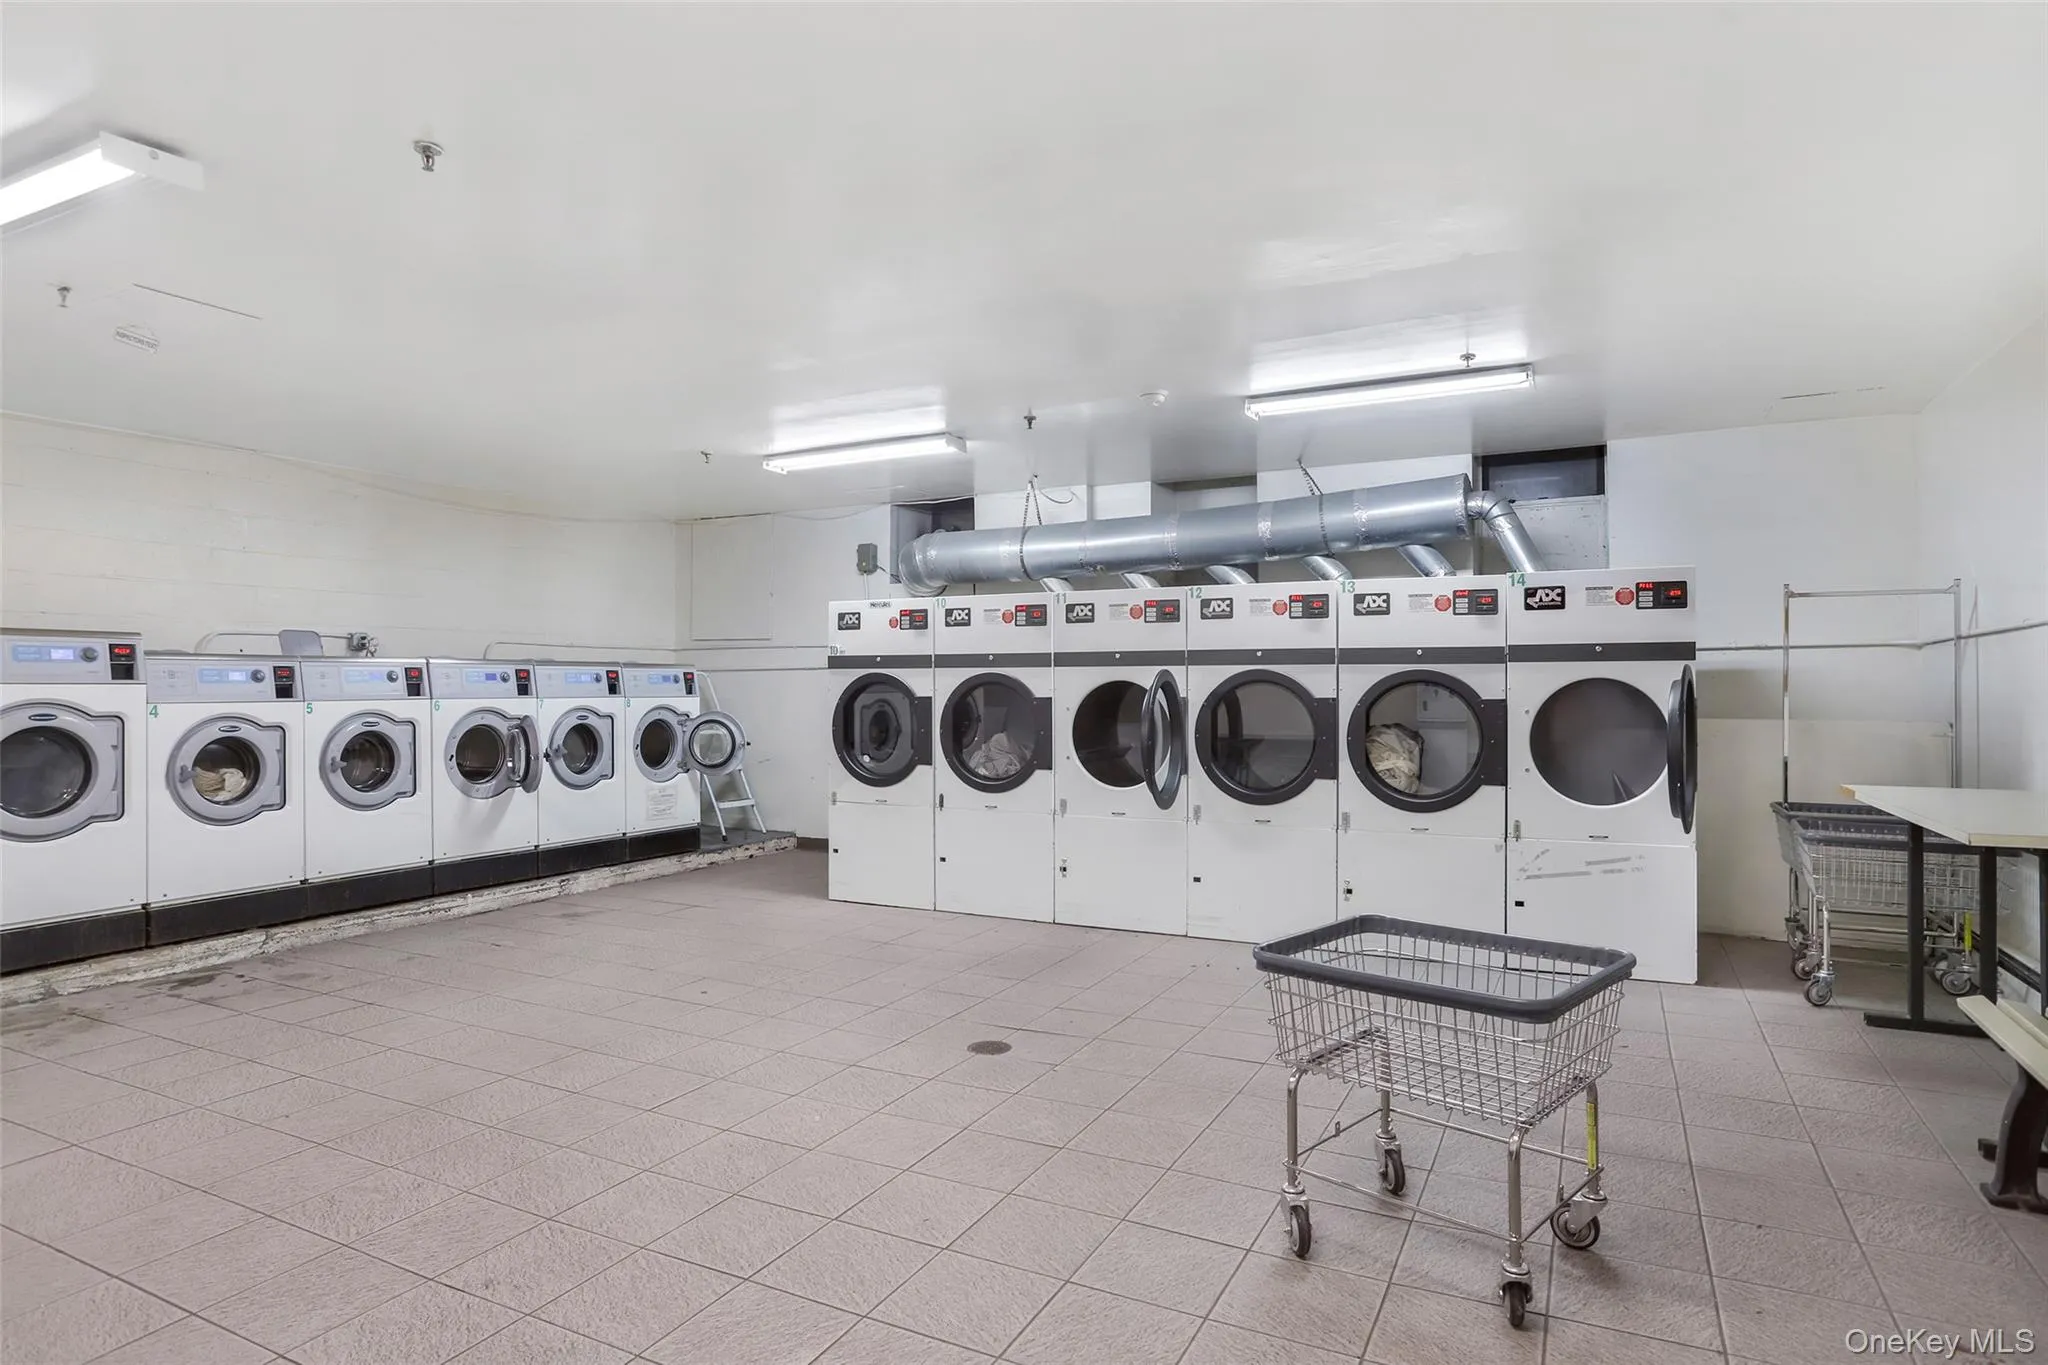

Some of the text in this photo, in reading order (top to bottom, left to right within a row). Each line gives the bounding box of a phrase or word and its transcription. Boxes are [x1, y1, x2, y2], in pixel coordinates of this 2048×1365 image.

[1509, 573, 1526, 586] 14
[1189, 587, 1202, 598] 12
[1341, 581, 1356, 593] 13
[1055, 593, 1067, 604] 11
[1536, 588, 1562, 602] ADC
[936, 598, 946, 608] 10
[149, 705, 159, 718] 4
[306, 702, 313, 714] 5
[434, 700, 441, 711] 6
